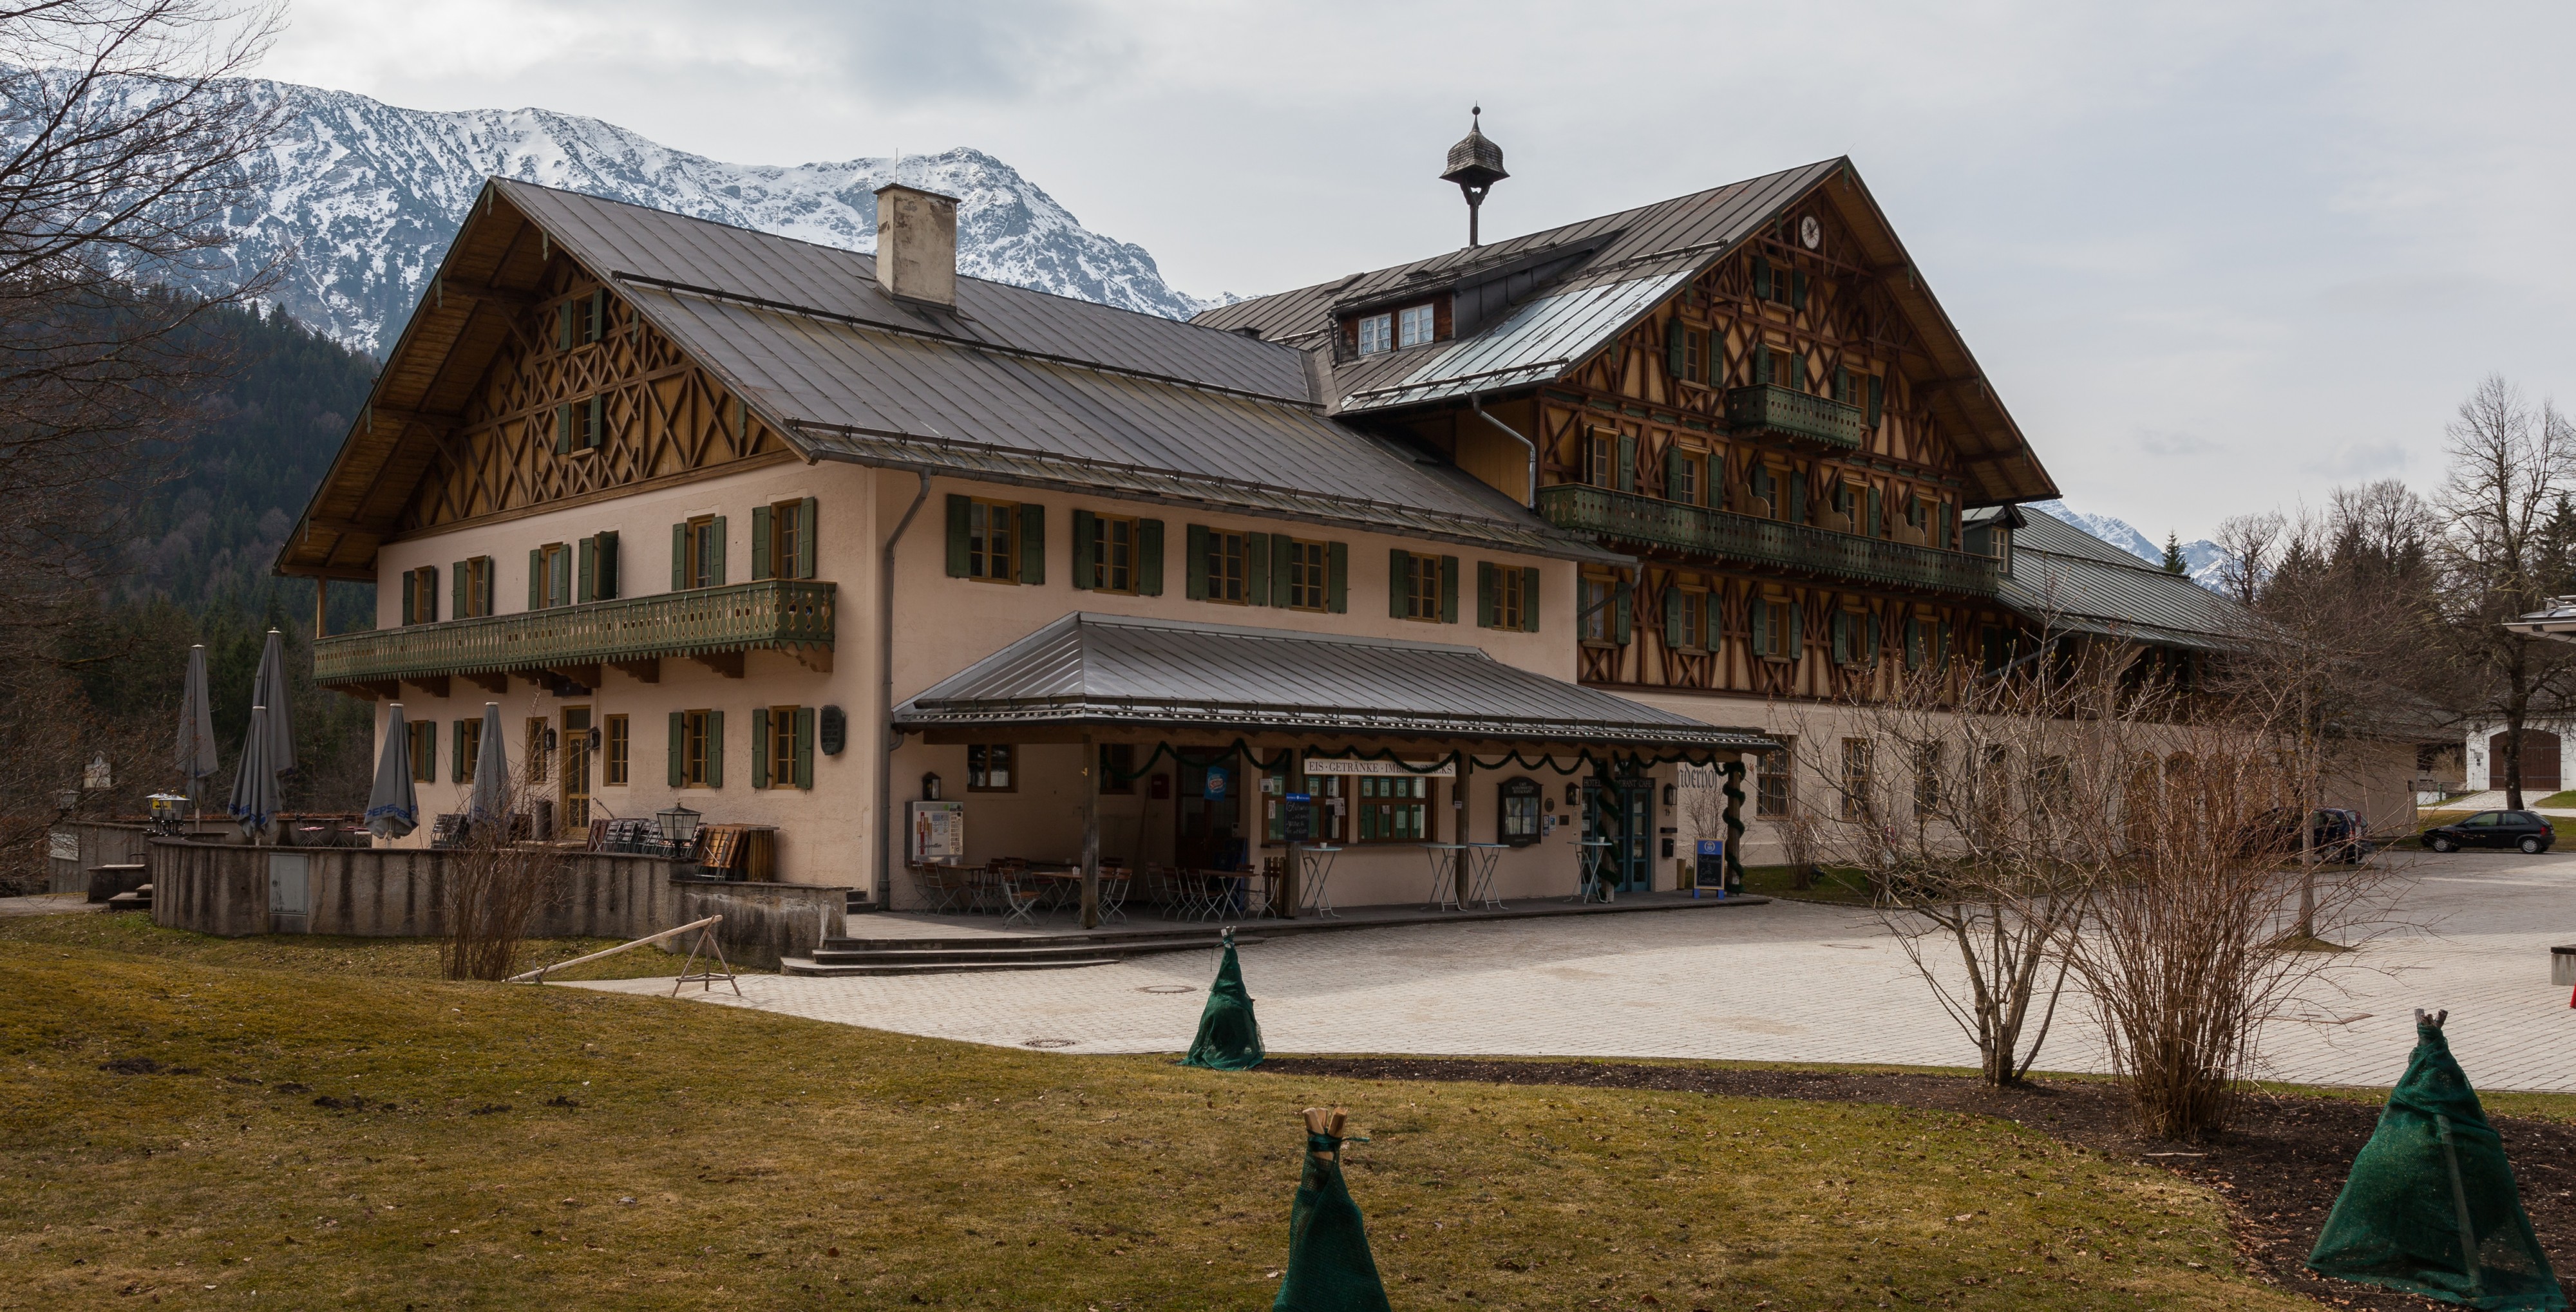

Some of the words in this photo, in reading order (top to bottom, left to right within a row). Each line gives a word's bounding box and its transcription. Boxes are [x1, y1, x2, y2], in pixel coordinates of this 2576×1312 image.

[1309, 762, 1323, 771] EIS
[1329, 762, 1379, 773] GETRÄNKE
[1584, 778, 1602, 787] HOTEL
